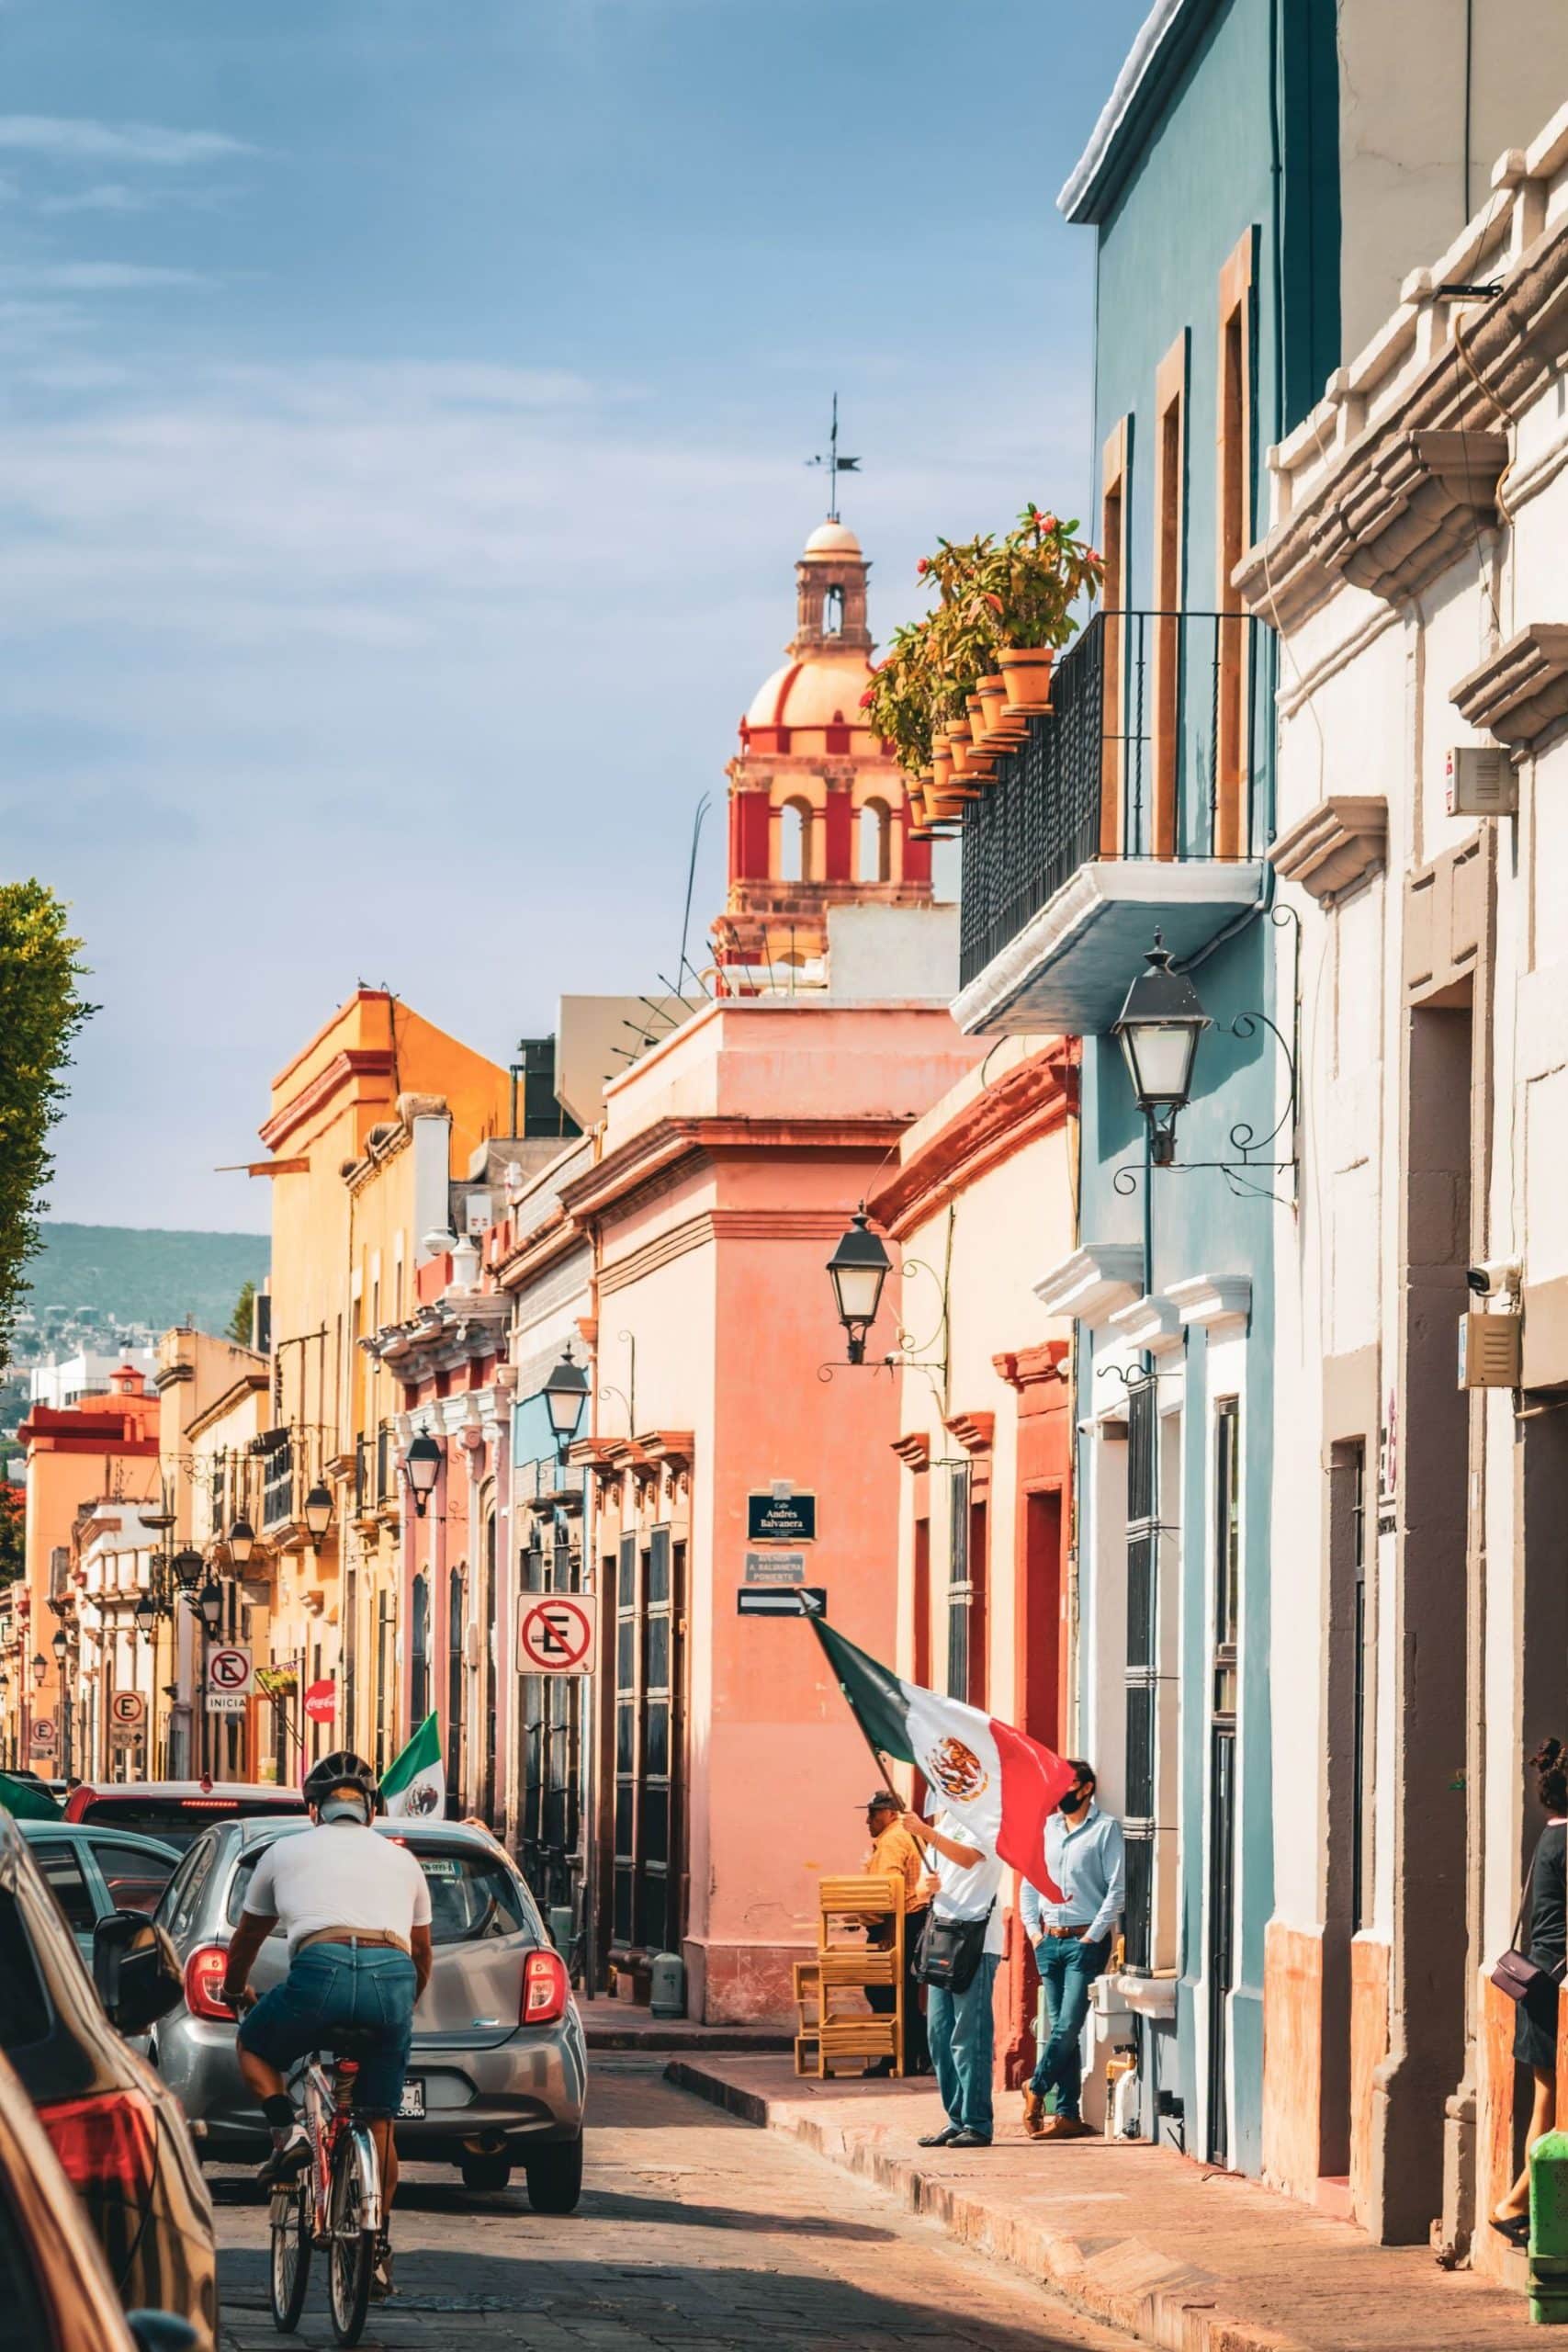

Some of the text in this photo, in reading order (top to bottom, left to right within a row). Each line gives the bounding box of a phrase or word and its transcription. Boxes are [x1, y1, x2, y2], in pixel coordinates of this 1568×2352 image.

[760, 1519, 803, 1528] Balvanera
[753, 1573, 794, 1581] PONIENTE
[543, 1615, 570, 1653] E
[220, 1657, 237, 1681] E
[120, 1698, 134, 1716] E
[39, 1724, 48, 1737] E
